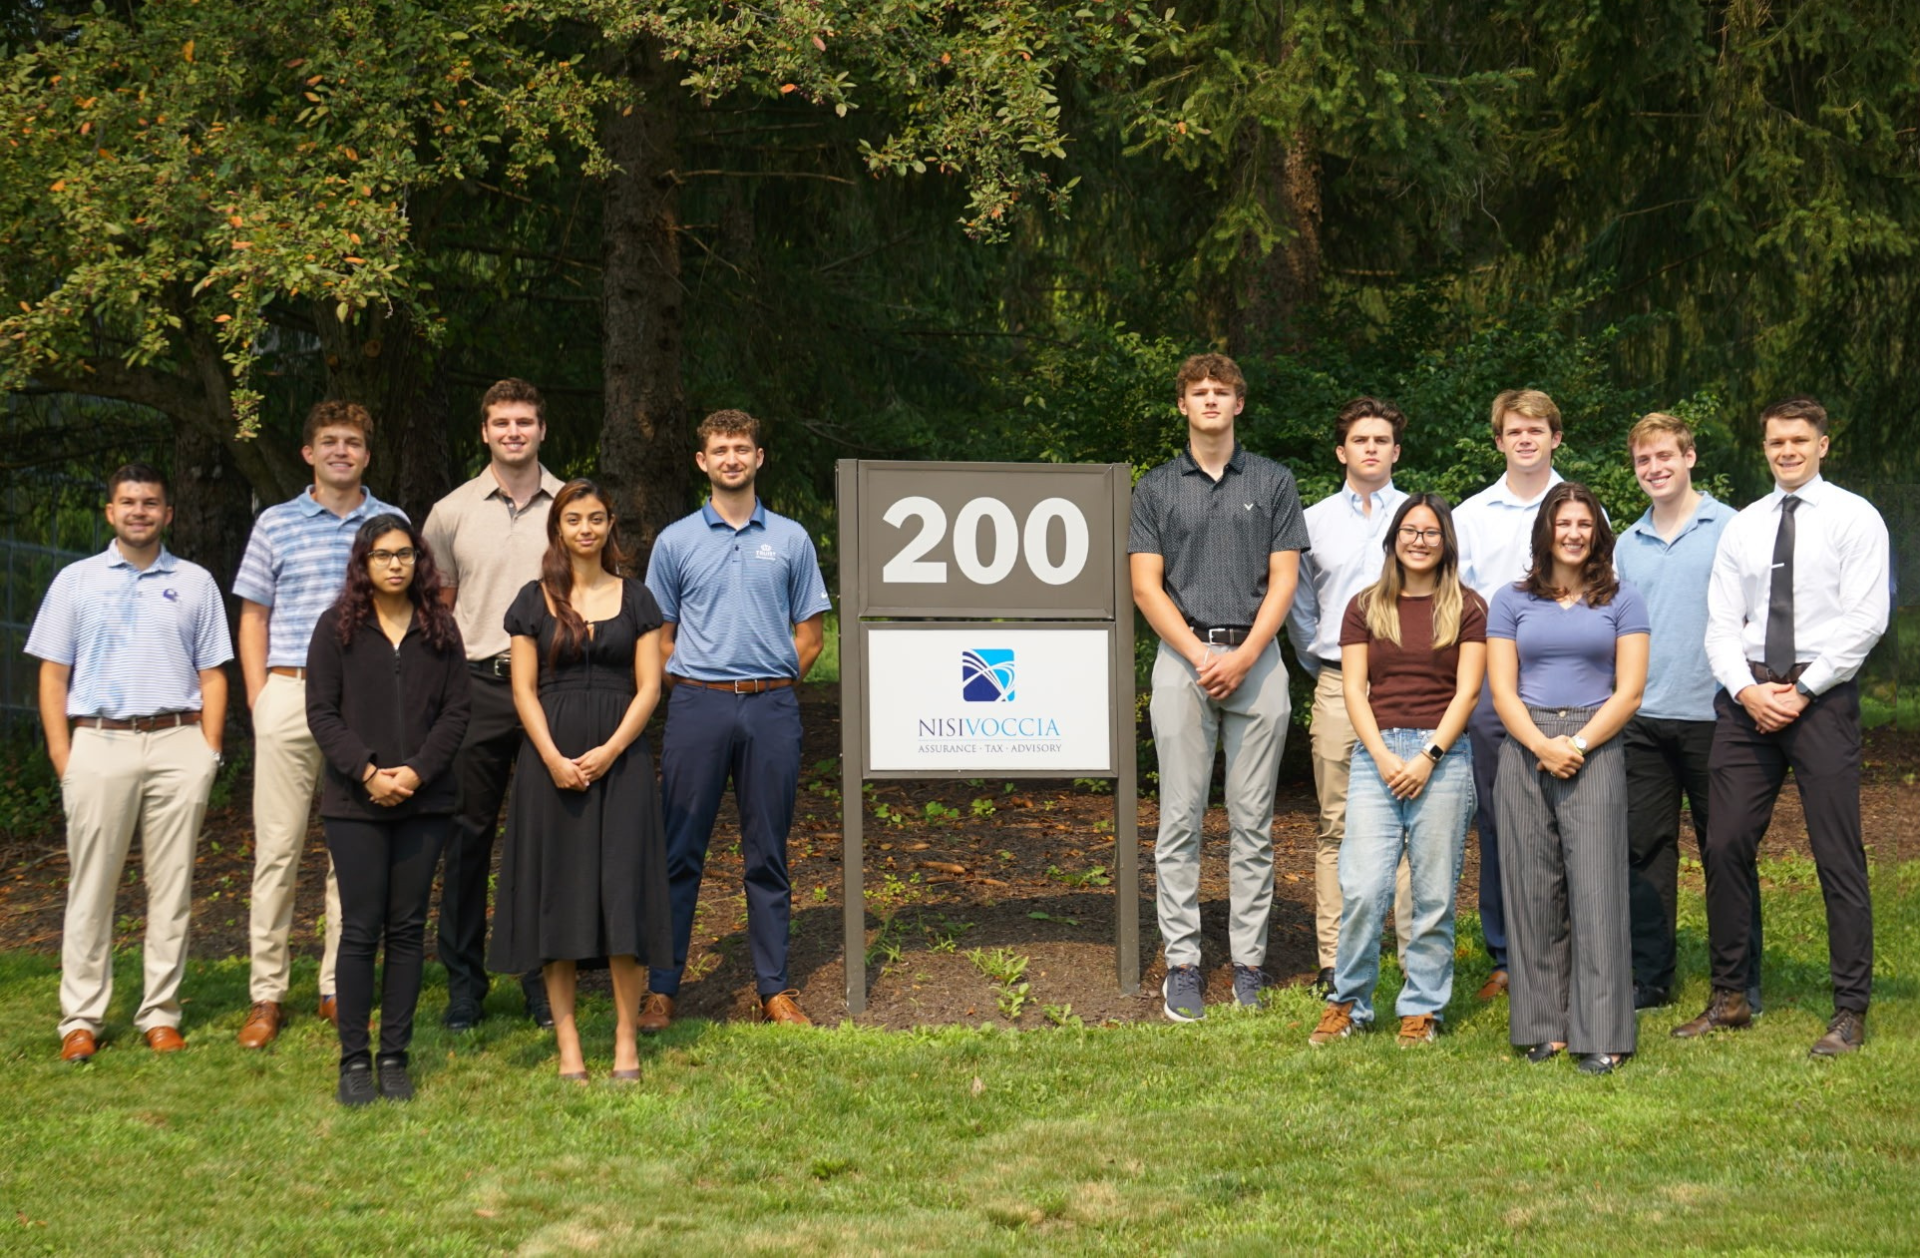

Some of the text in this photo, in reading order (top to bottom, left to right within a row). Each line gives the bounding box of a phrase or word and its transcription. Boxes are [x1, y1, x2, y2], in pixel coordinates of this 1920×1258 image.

[882, 496, 1089, 585] 200
[918, 718, 1060, 737] NISIVOCCIA
[918, 744, 1062, 753] ASSURANCE TAX ADVISORY
